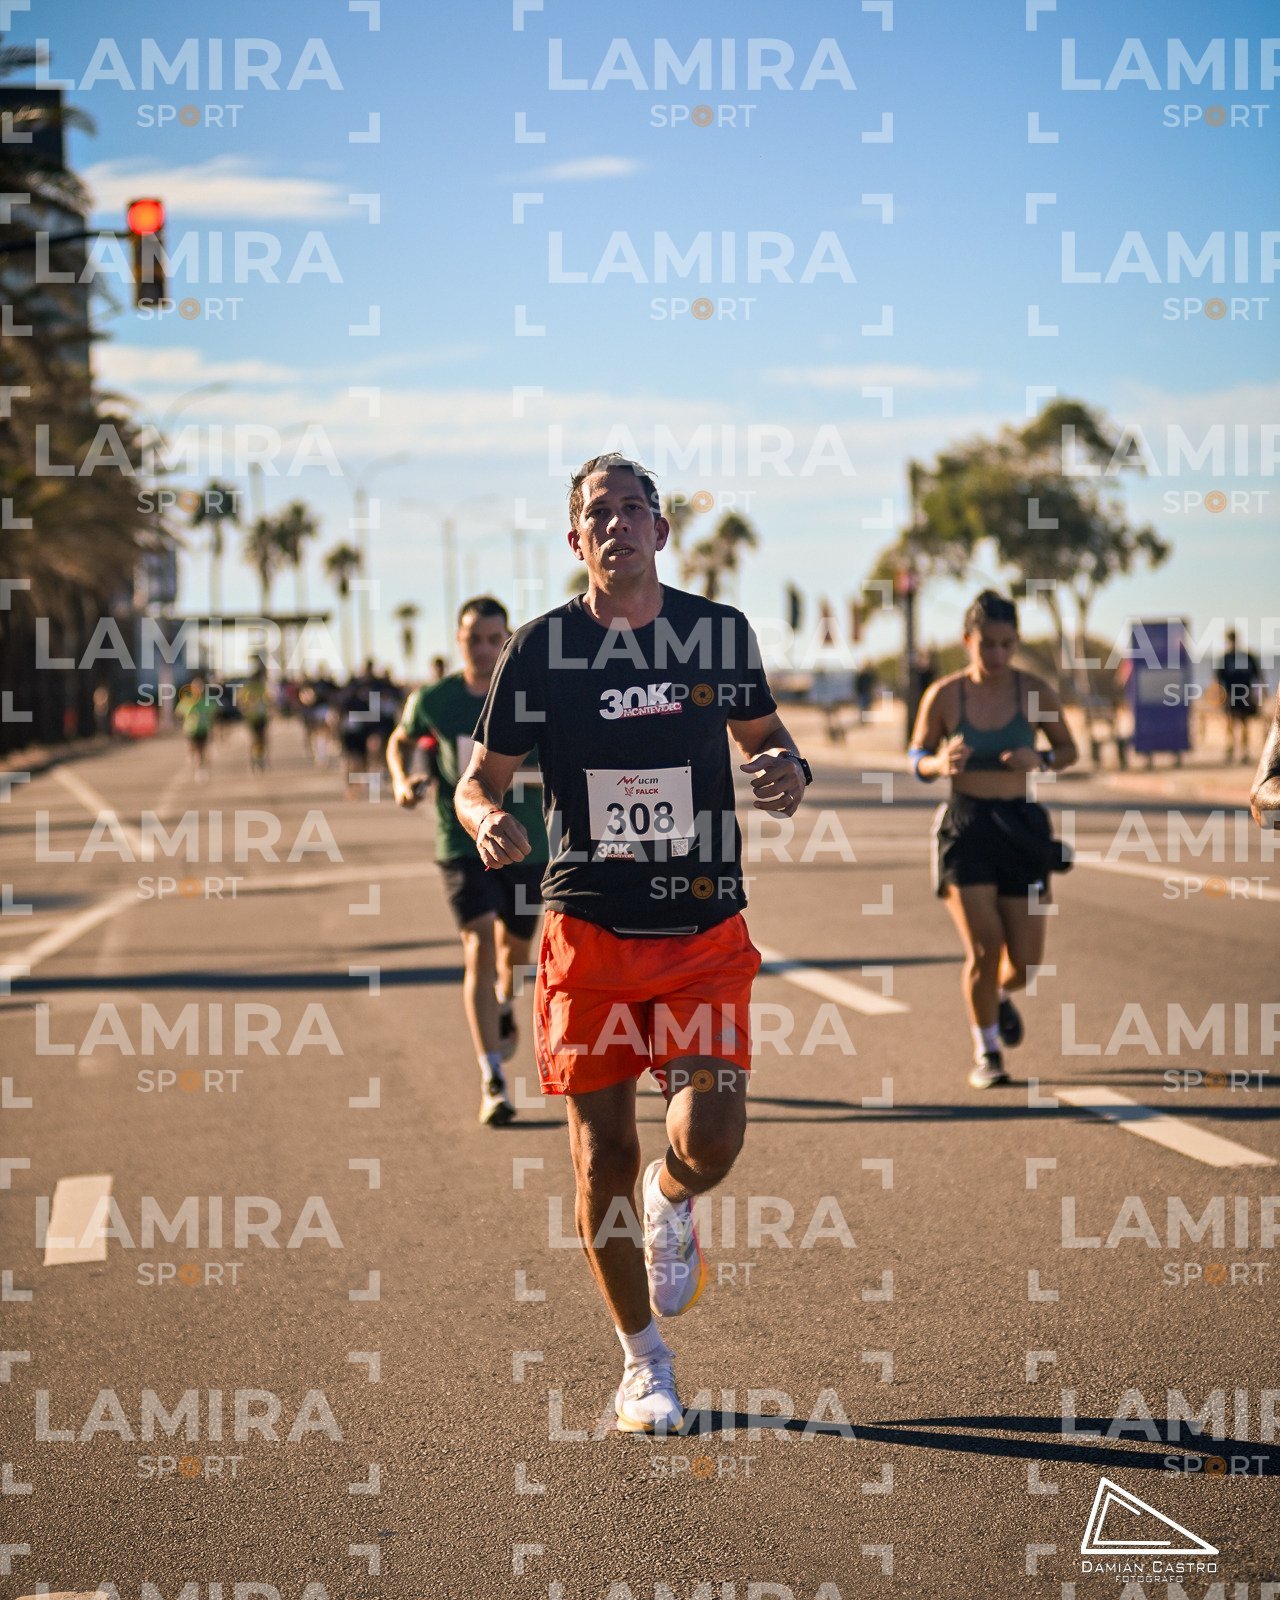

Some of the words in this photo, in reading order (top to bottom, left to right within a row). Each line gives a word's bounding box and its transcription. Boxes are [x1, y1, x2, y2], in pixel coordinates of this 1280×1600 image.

[599, 682, 672, 720] 30K
[623, 702, 682, 718] MONTEVIDEO
[638, 777, 659, 785] ucm
[606, 801, 675, 835] 308
[597, 842, 631, 858] 30K
